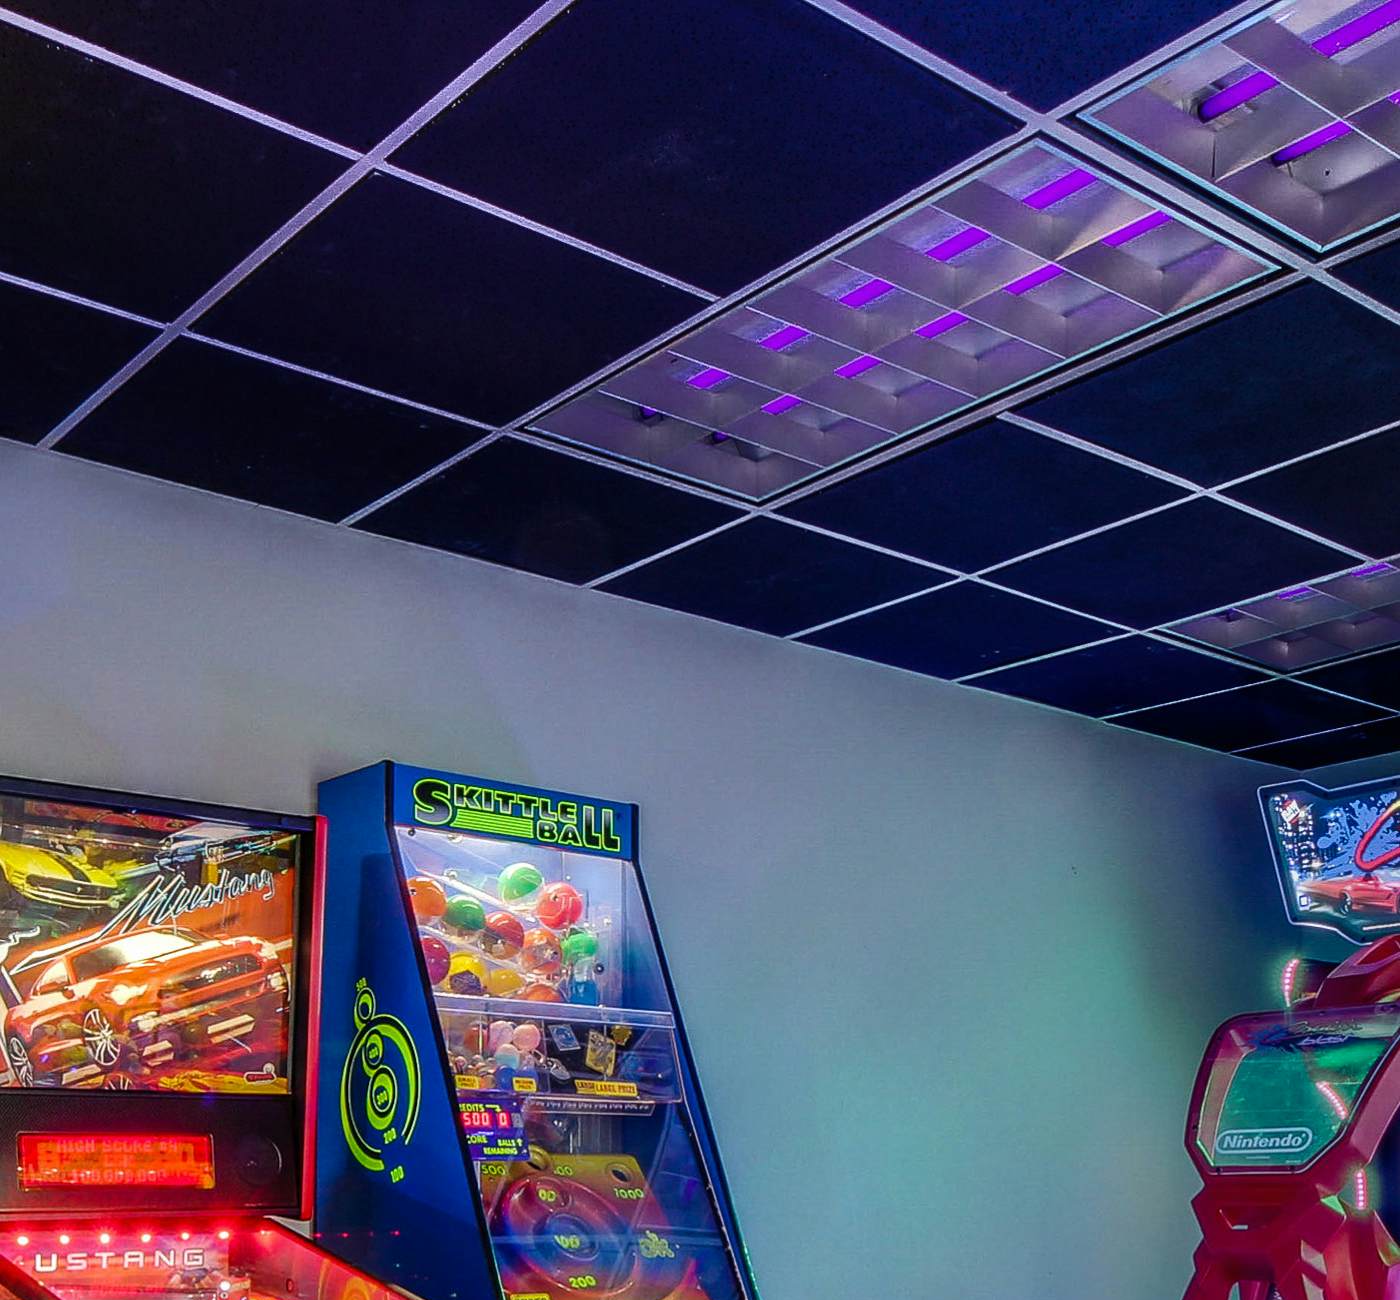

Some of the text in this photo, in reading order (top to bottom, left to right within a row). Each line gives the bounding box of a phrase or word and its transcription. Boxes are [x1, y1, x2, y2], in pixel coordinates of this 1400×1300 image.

[413, 778, 577, 826] SKITTLE
[536, 804, 620, 852] BALL
[462, 1111, 490, 1126] 500
[1222, 1133, 1303, 1149] Nintendo
[569, 1275, 597, 1288] 200
